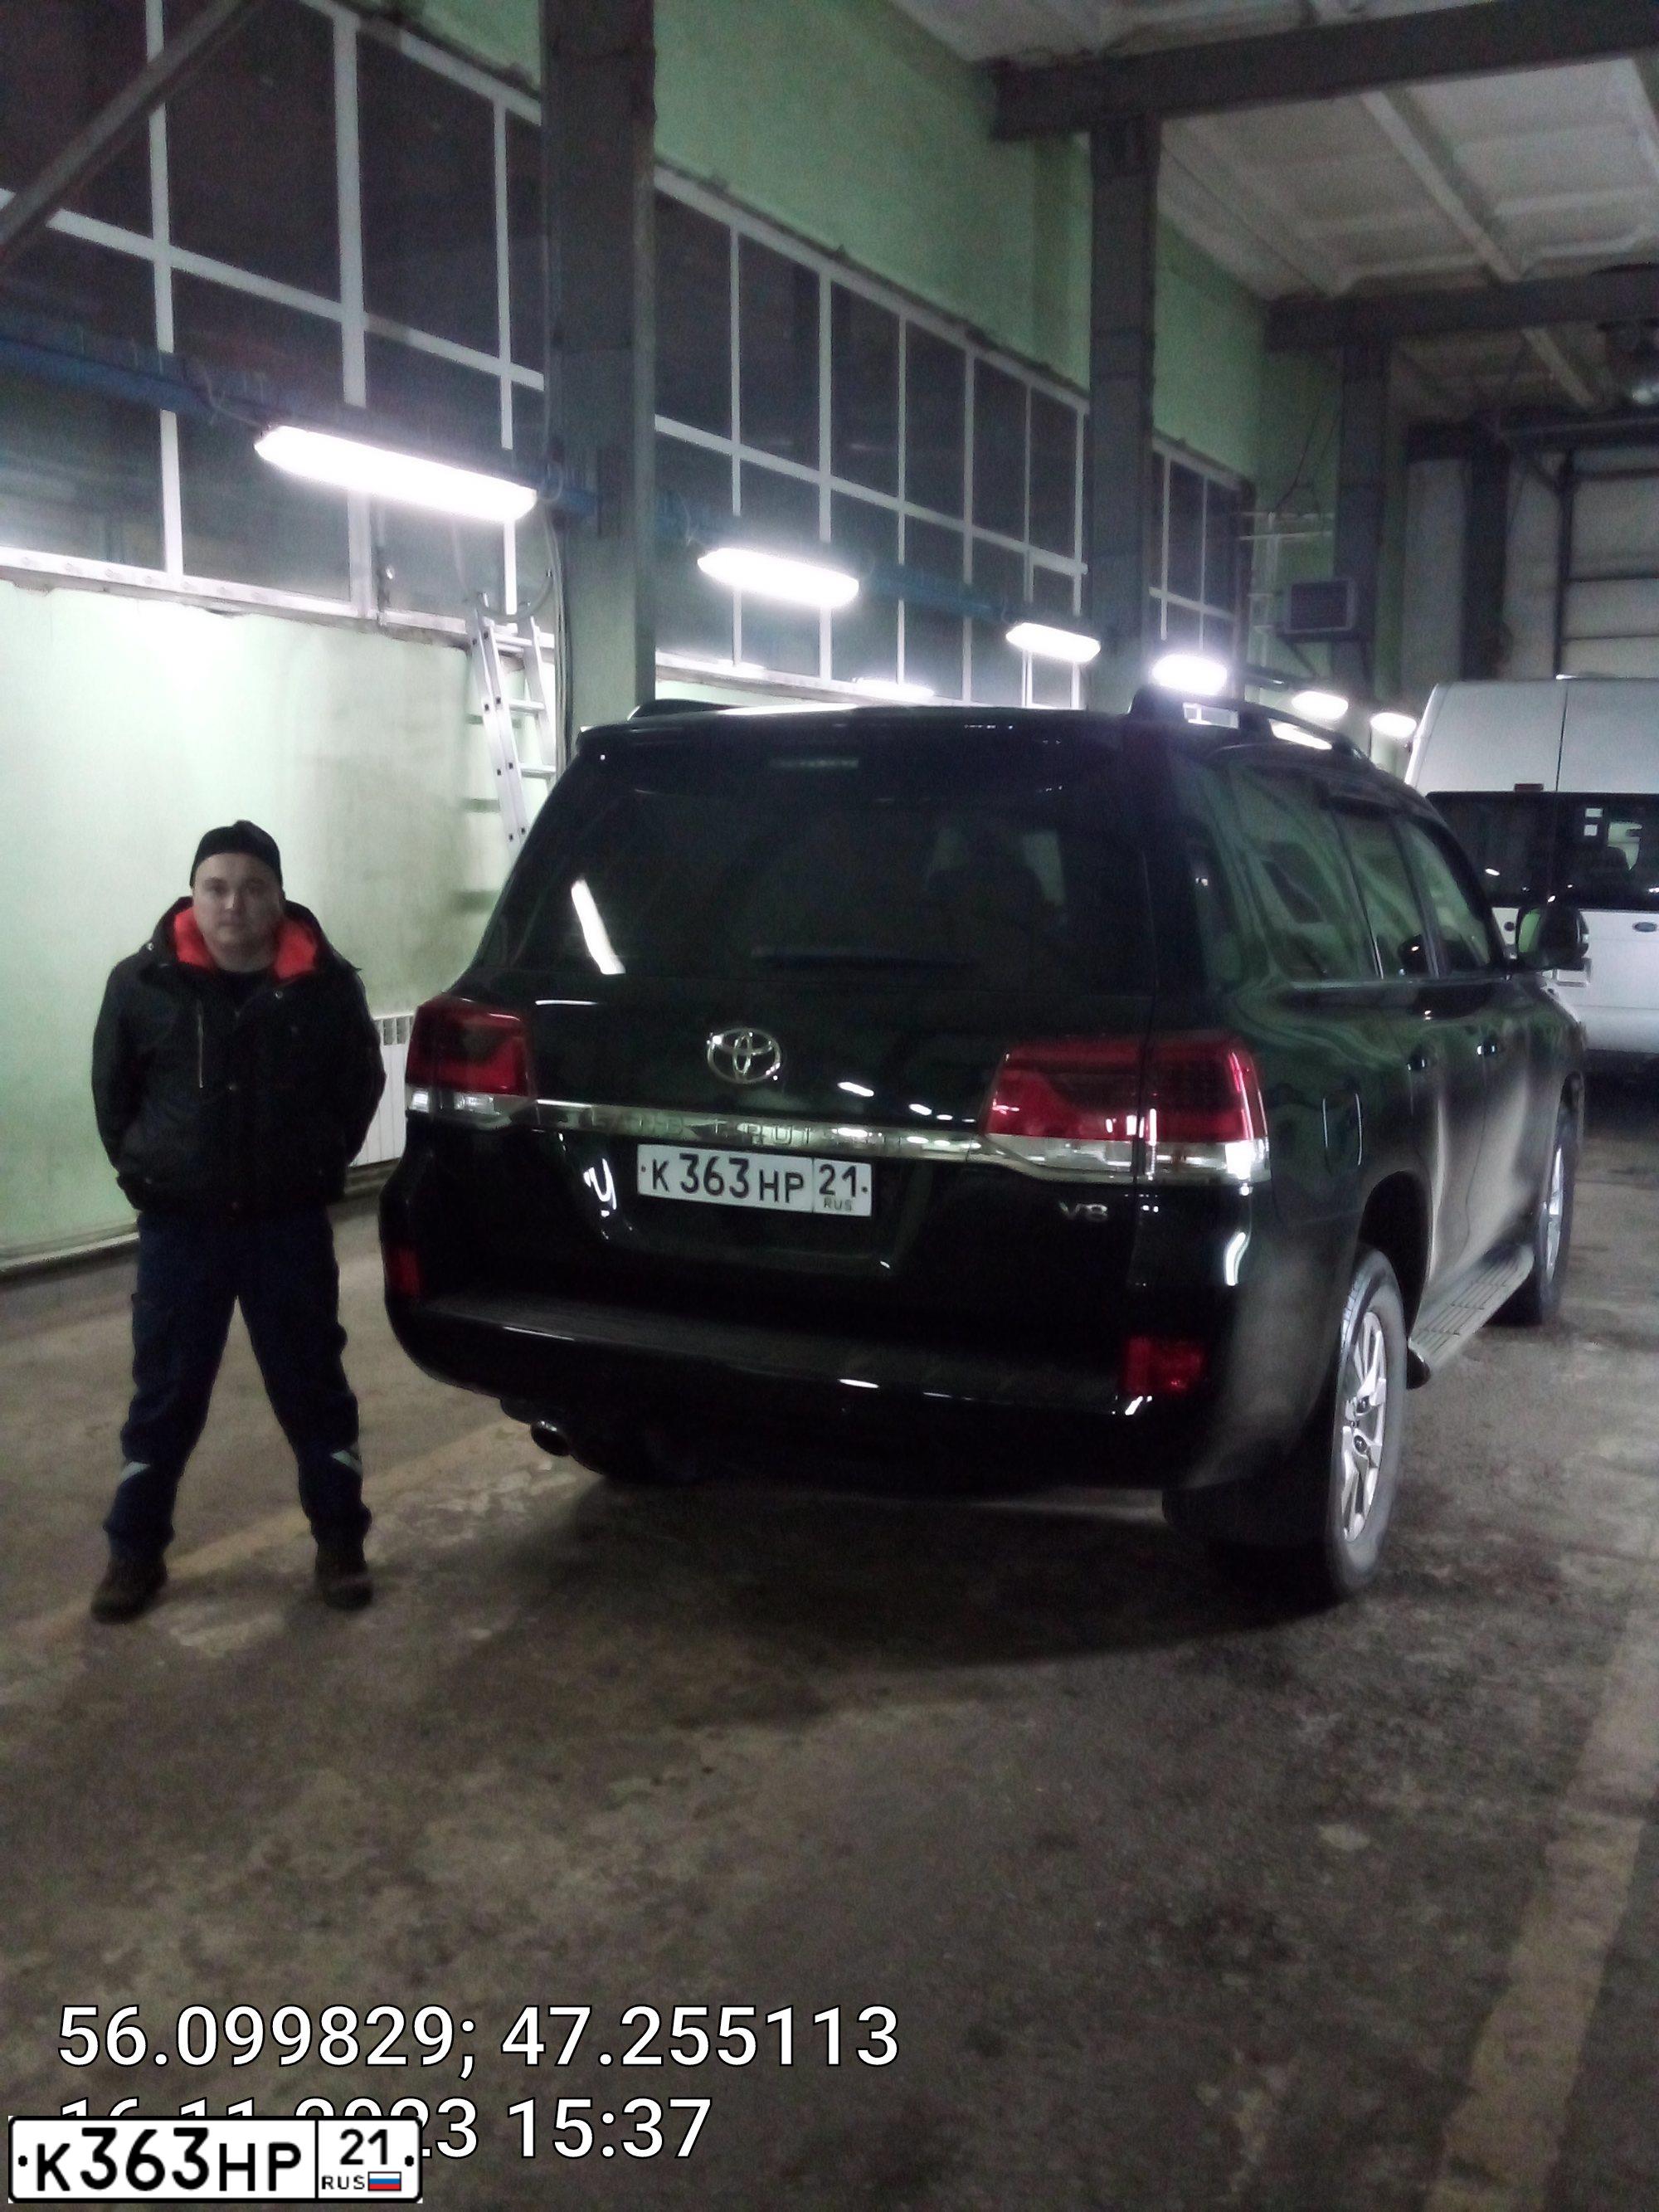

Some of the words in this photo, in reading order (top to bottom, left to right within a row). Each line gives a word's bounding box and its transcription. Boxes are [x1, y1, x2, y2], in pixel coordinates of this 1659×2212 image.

[819, 1164, 858, 1198] 21
[824, 1197, 853, 1212] RUS
[1058, 1201, 1108, 1223] V8
